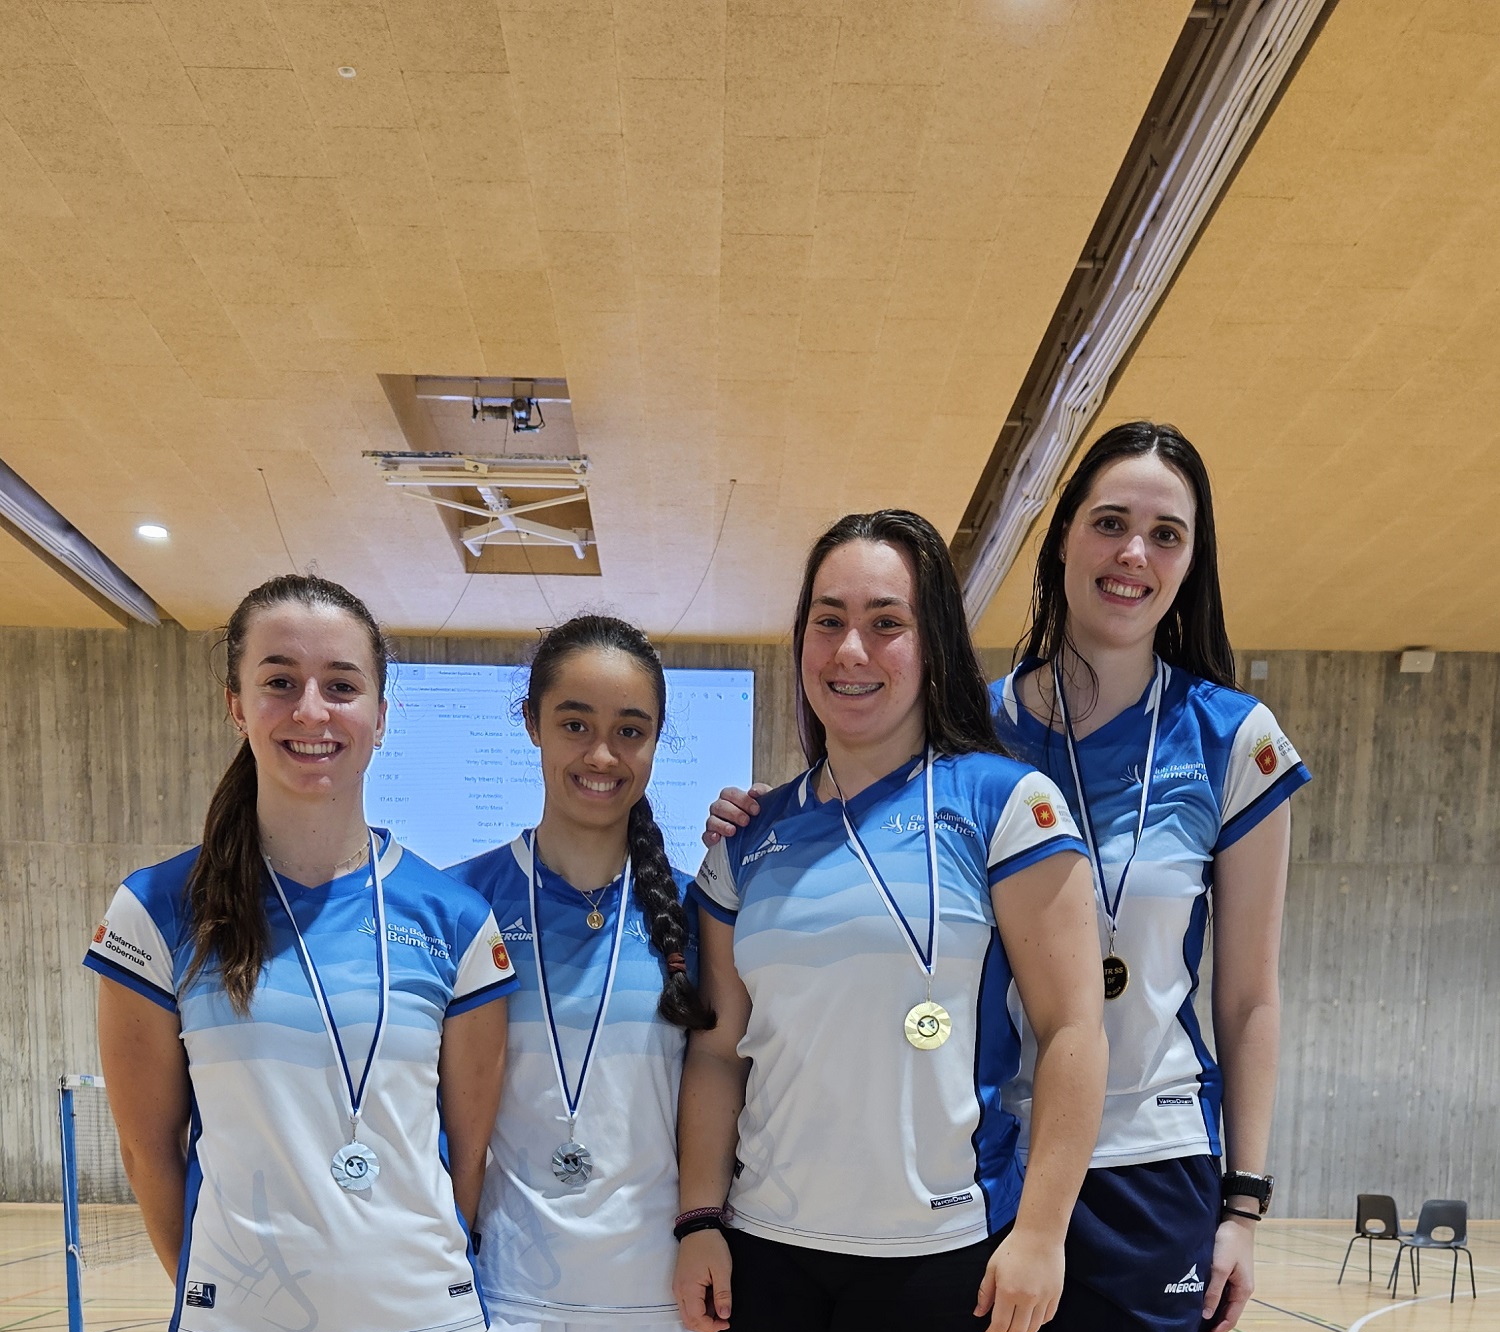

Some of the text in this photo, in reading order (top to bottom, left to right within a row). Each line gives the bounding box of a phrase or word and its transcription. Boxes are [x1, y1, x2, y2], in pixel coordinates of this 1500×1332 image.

[906, 821, 976, 838] Beecher
[387, 923, 408, 933] Club
[500, 932, 534, 941] ERCUR
[105, 940, 145, 967] Gobernua
[108, 930, 152, 962] Nafarroako
